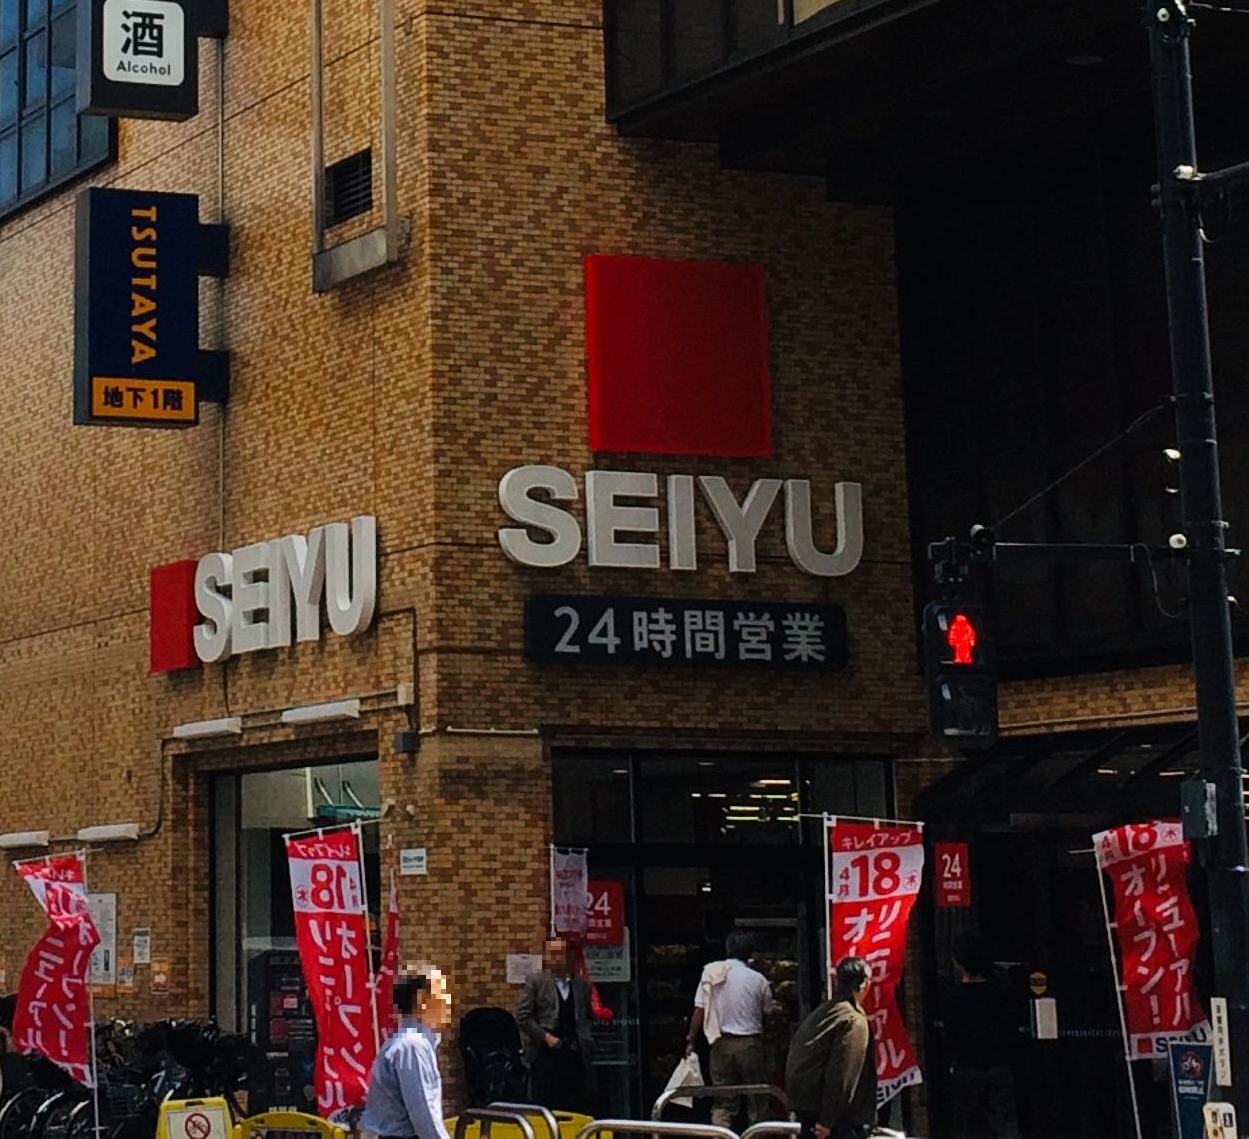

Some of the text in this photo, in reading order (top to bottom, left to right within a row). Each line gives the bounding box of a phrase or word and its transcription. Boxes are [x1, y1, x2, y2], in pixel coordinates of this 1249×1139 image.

[120, 10, 165, 59] 酒
[116, 61, 171, 76] Alcohol
[131, 206, 157, 365] TSUTAYA
[103, 385, 183, 411] 地下1階
[498, 464, 864, 577] SEIYU
[193, 515, 376, 663] SEIYU
[554, 605, 826, 662] 24時間営業
[851, 852, 901, 898] 18
[942, 853, 962, 878] 24
